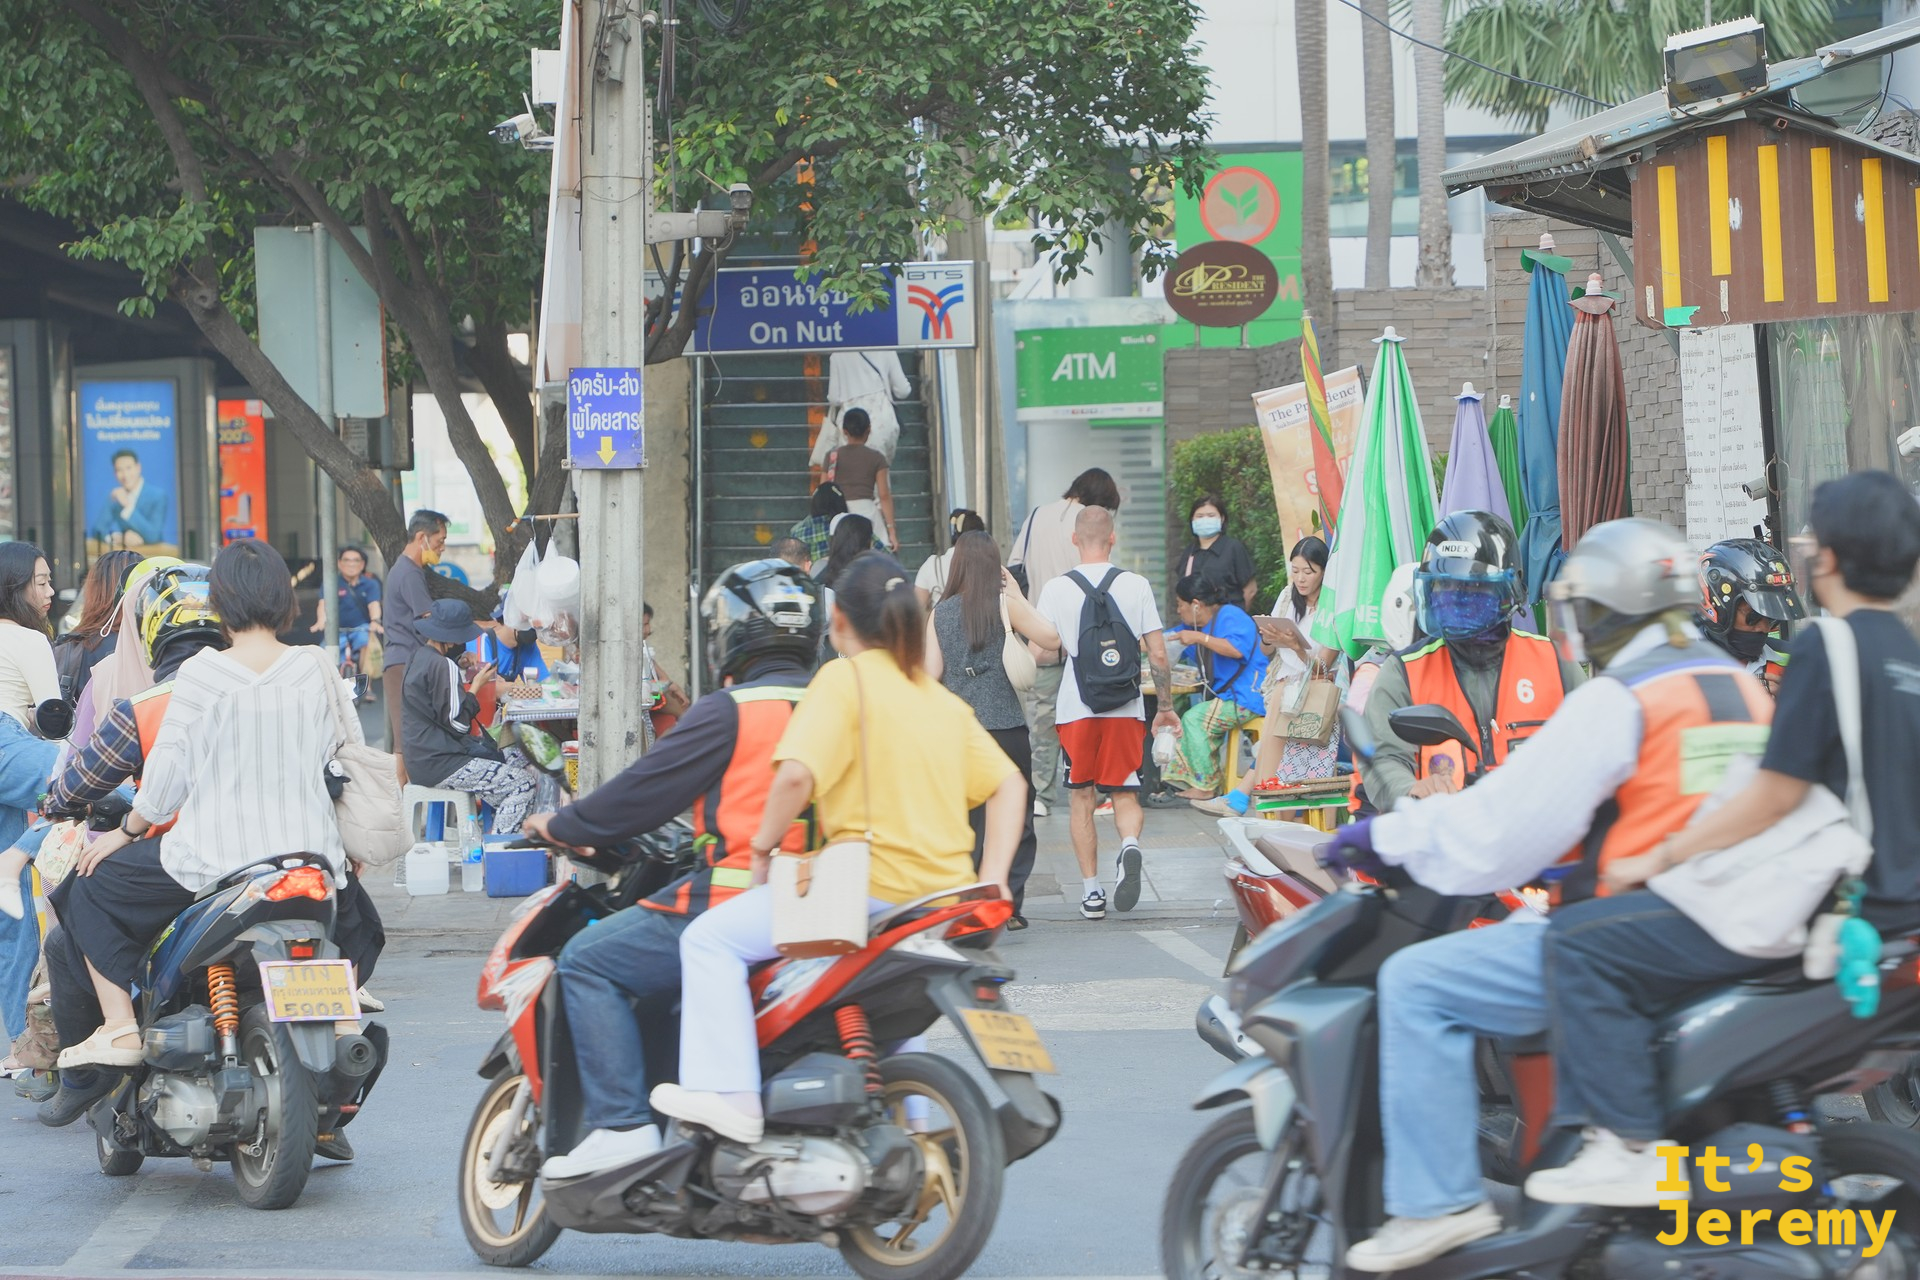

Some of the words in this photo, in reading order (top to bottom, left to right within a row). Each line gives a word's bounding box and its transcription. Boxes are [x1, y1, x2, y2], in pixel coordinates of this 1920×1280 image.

[906, 269, 963, 280] BTS
[750, 322, 787, 344] On
[797, 320, 843, 343] Nut
[1051, 351, 1117, 381] ATM
[570, 372, 639, 403] จุดรับ-ส่ง
[572, 403, 641, 438] ผู้โดยสาร
[1268, 408, 1293, 422] The
[1442, 545, 1469, 553] INDEX
[1516, 678, 1535, 704] 6
